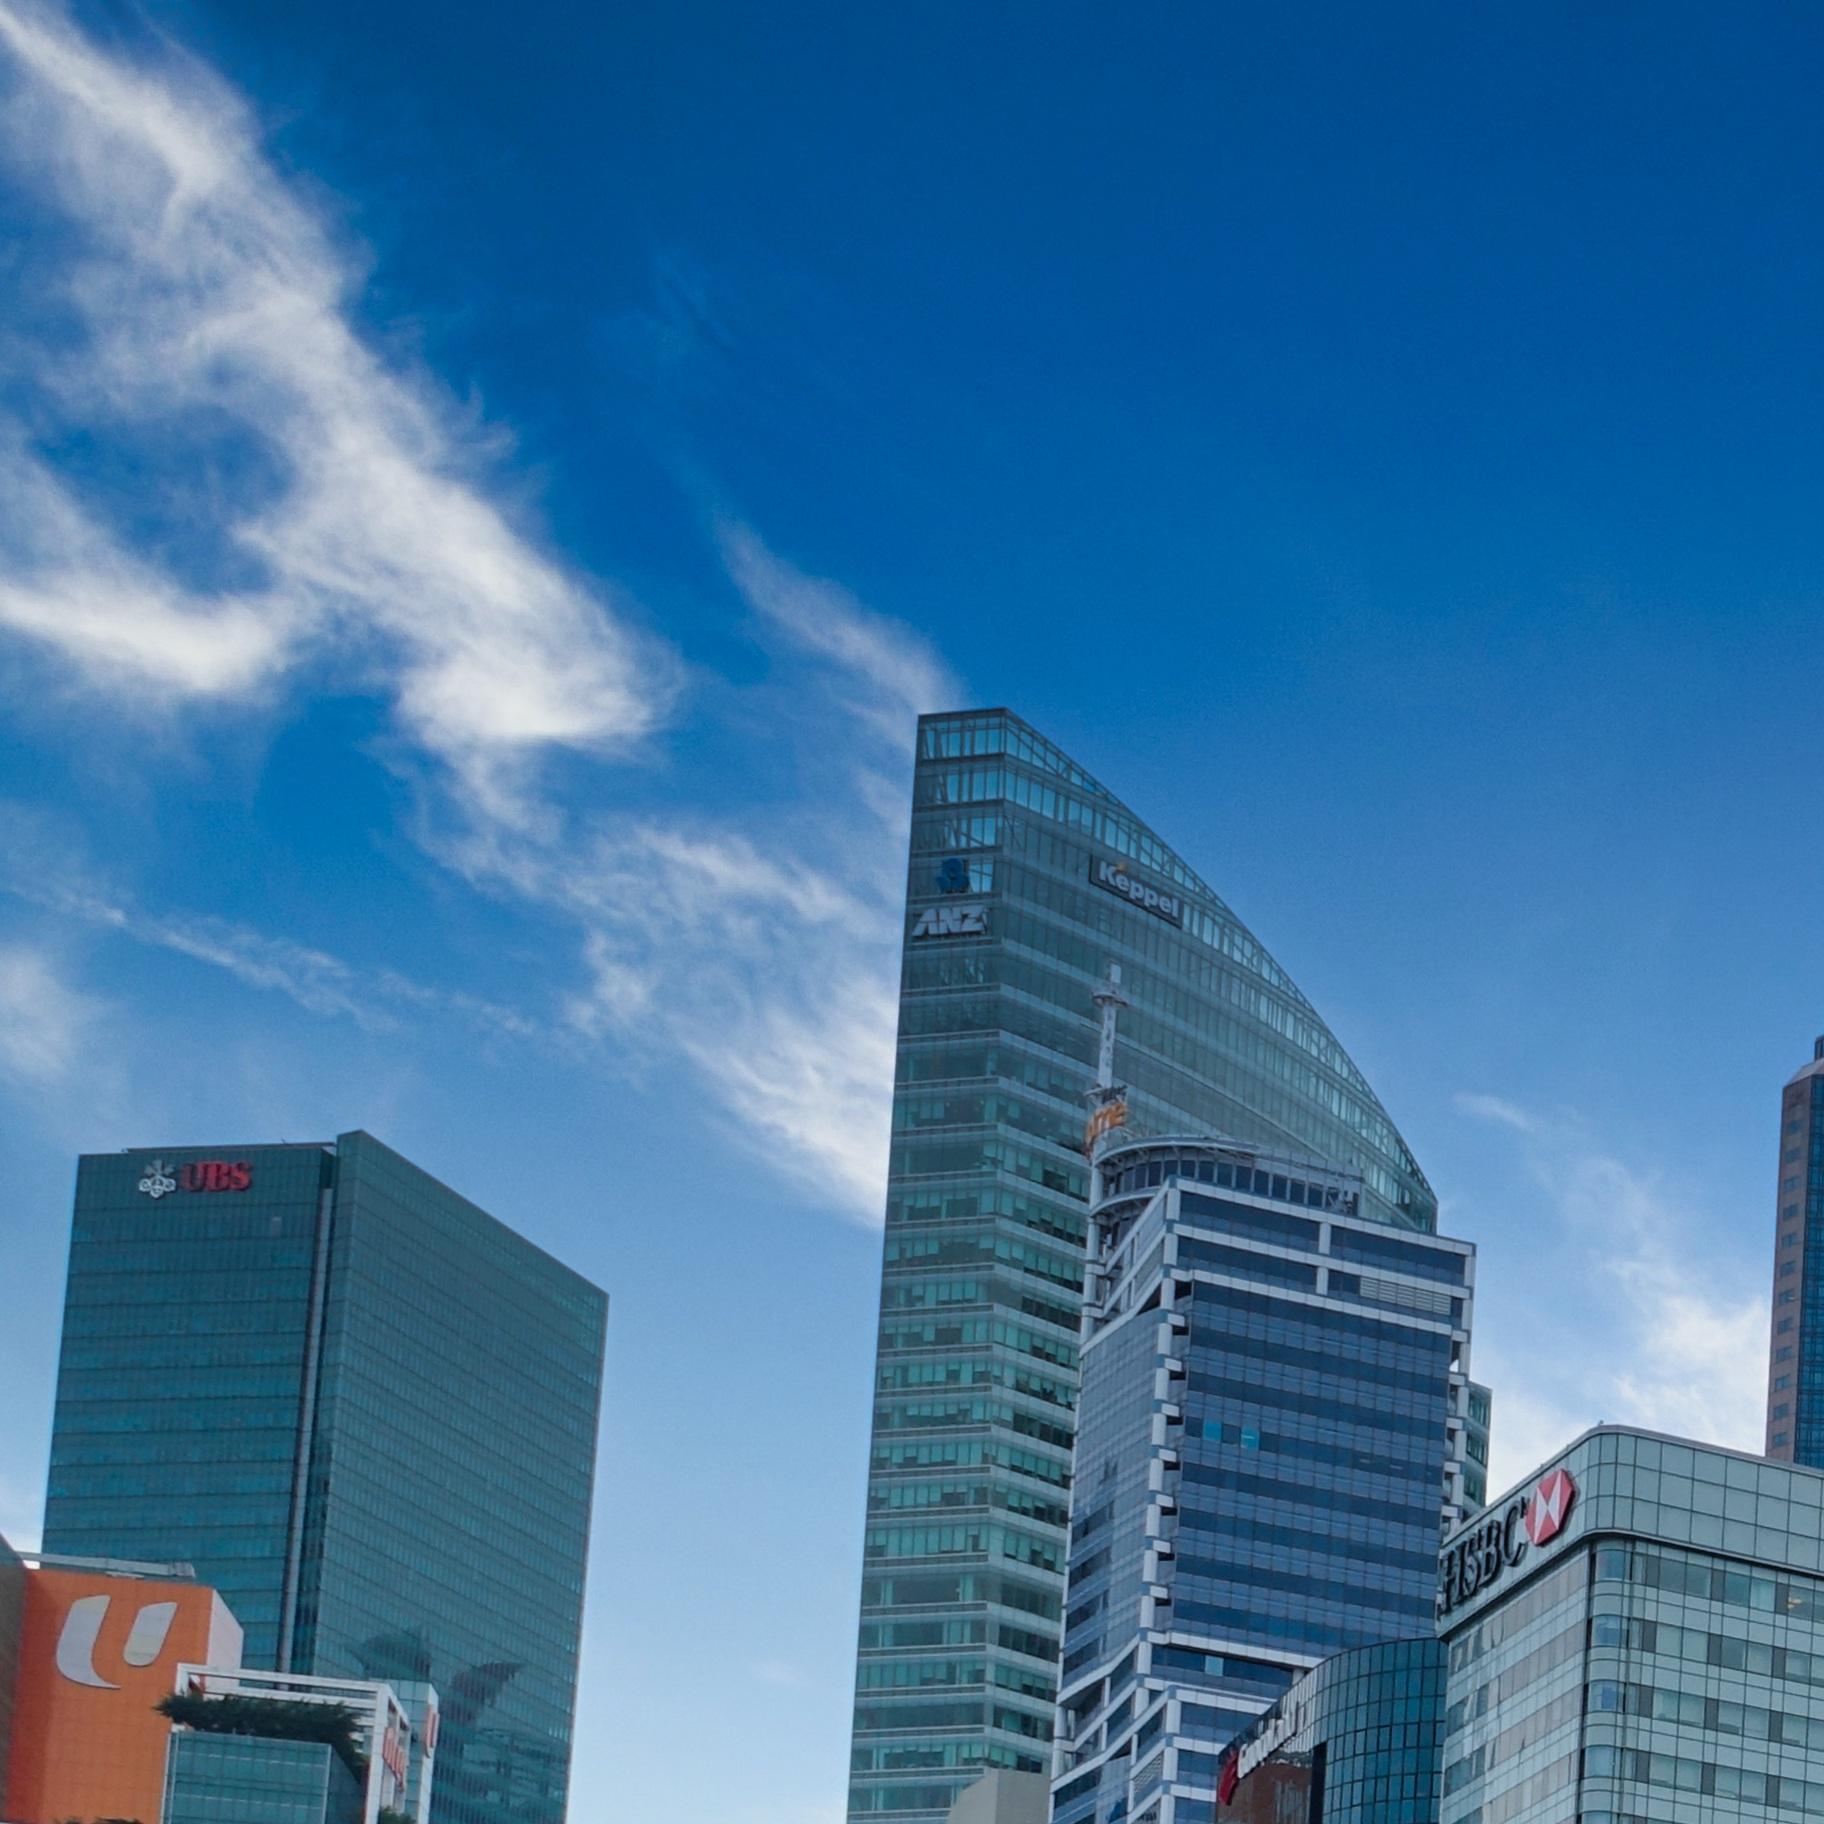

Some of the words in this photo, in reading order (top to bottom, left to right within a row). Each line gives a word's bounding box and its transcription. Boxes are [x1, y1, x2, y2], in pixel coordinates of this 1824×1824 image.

[1099, 860, 1180, 918] Keppel
[911, 905, 989, 937] ANZ
[180, 1161, 252, 1192] UBS
[1438, 1496, 1529, 1614] HSBC
